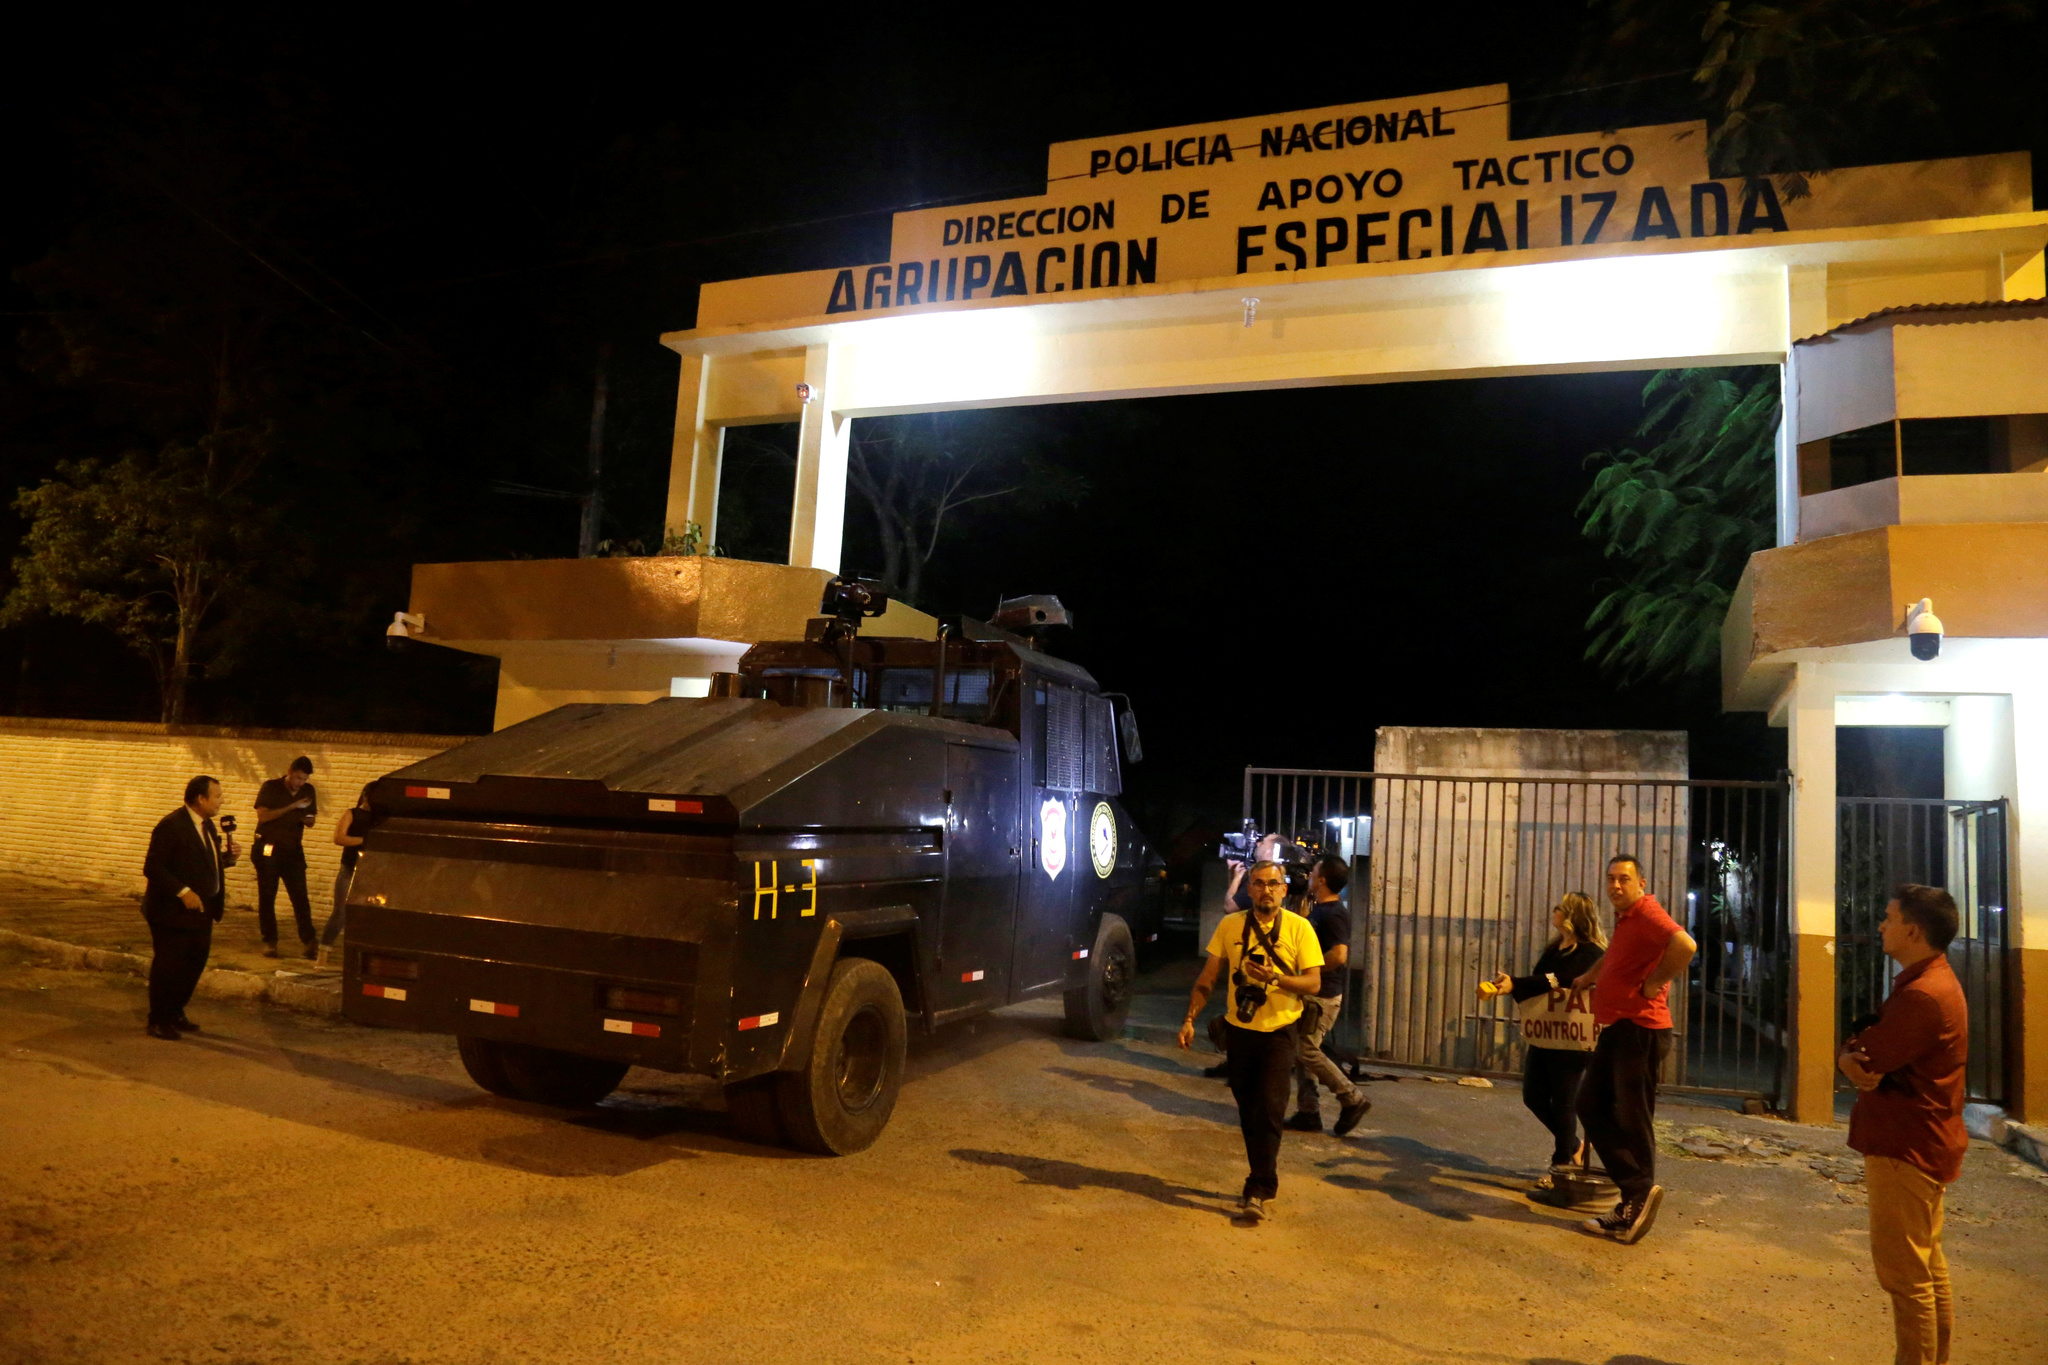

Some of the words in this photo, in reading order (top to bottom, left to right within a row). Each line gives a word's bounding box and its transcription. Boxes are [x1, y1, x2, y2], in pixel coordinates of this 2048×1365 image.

[1090, 134, 1233, 179] POLICIA
[1260, 106, 1455, 158] NACIONAL
[943, 199, 1115, 247] DIRECCION
[1161, 189, 1210, 224] DE
[1257, 168, 1402, 212] APOYO
[1453, 144, 1634, 190] TACTICO
[825, 237, 1158, 315] AGRUPACION
[1236, 177, 1789, 275] ESPECIALIZADA
[753, 858, 817, 920] H-3
[1524, 1019, 1588, 1042] CONTROL
